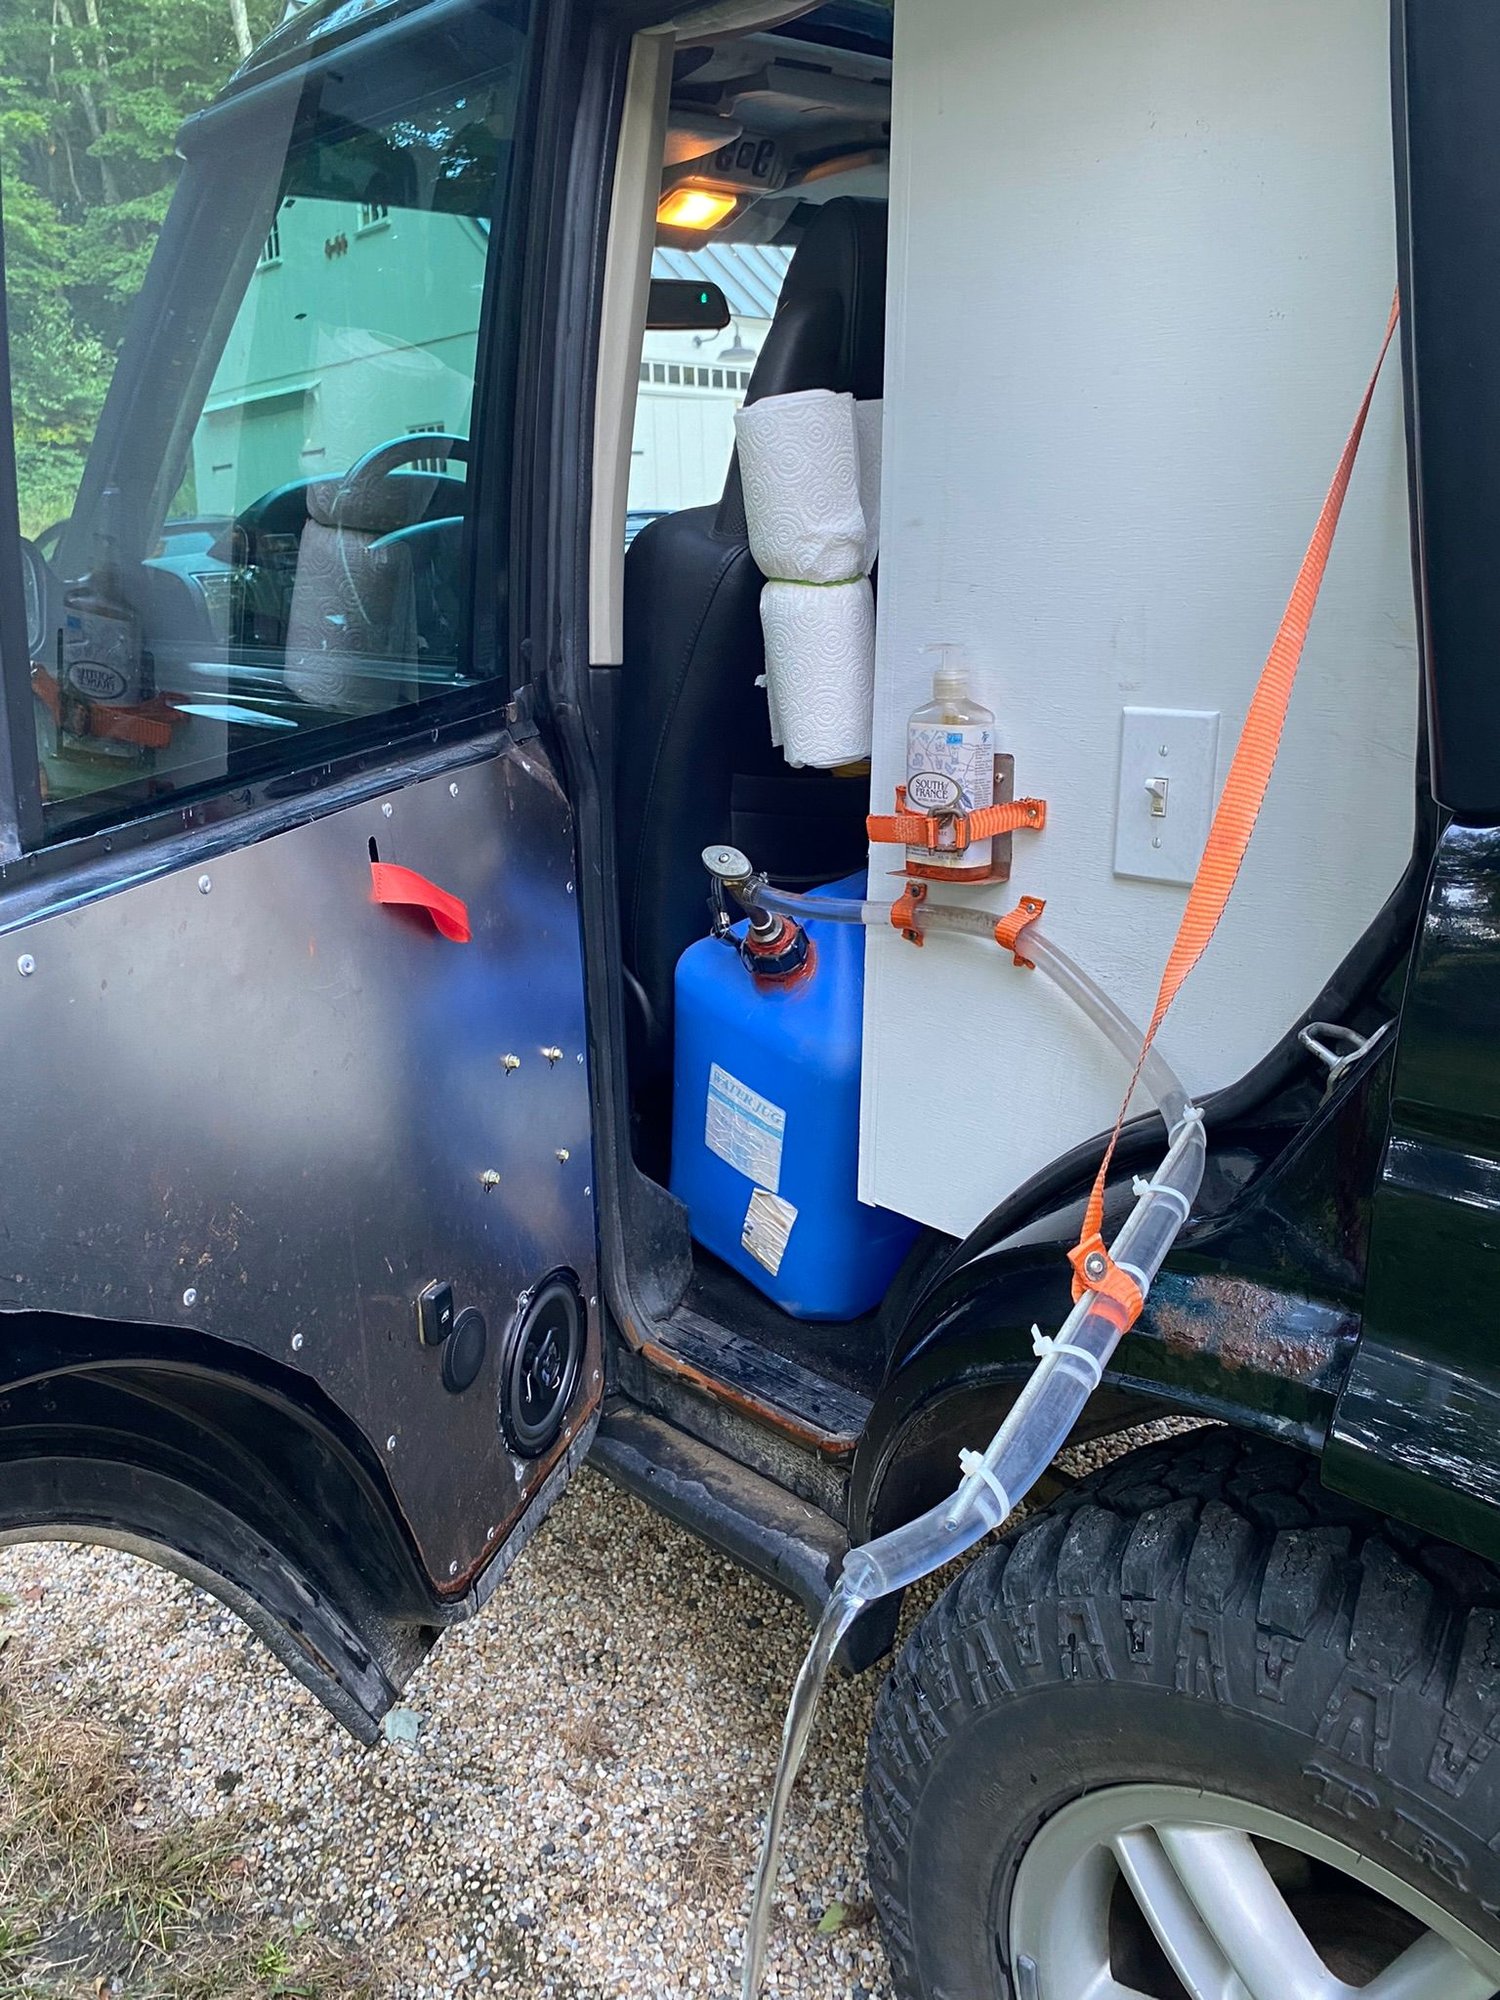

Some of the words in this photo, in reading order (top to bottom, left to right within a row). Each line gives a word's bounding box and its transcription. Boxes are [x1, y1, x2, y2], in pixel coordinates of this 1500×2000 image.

[915, 779, 945, 791] SOUTH
[915, 787, 949, 800] FRANCE
[714, 1071, 754, 1107] WATER
[752, 1102, 783, 1124] JUG
